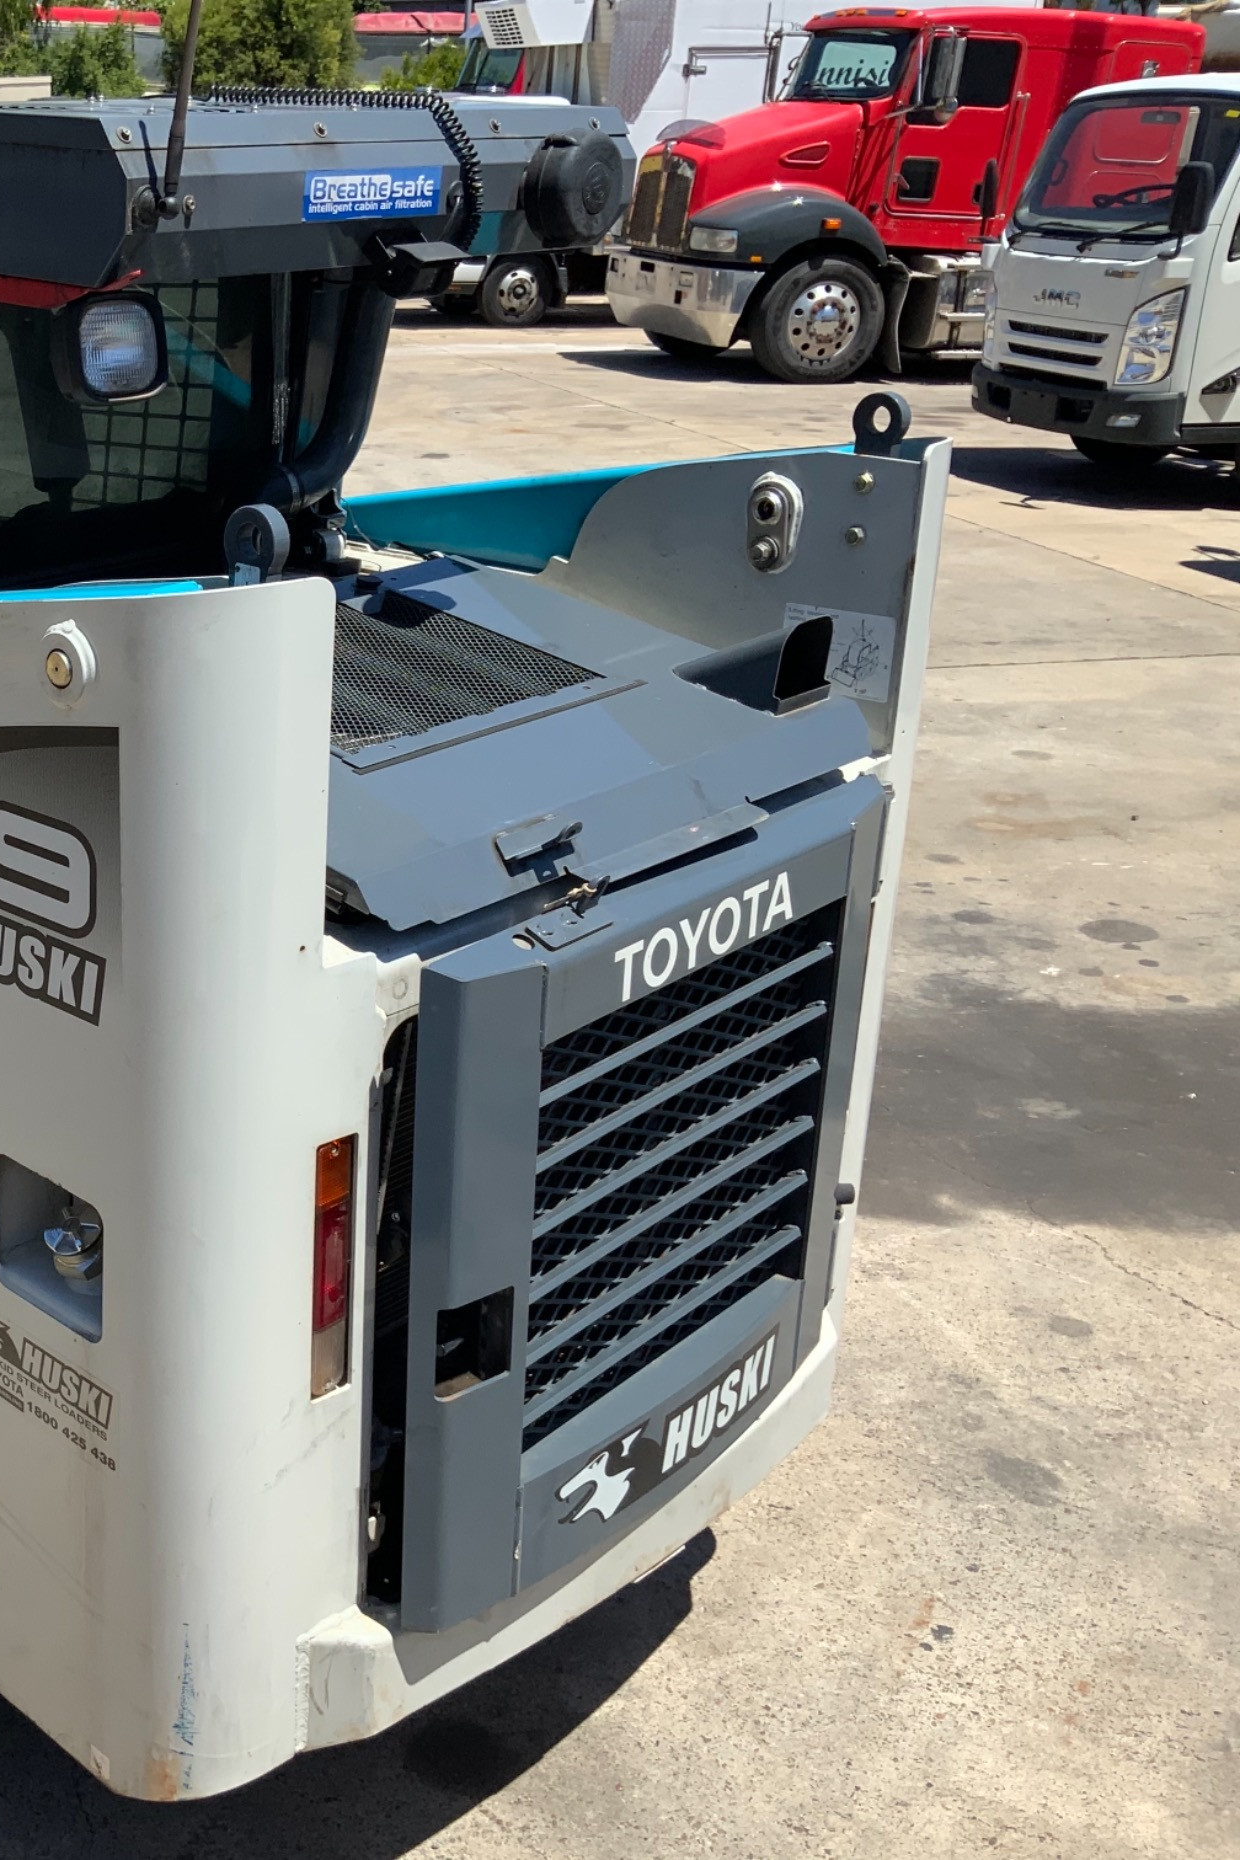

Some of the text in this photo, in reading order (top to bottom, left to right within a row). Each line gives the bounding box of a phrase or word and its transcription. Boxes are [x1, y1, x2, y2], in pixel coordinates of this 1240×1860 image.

[308, 199, 432, 214] intelligent cabin air filtration
[615, 871, 793, 1002] TOYOTA
[16, 1374, 52, 1403] STEER
[54, 1398, 108, 1441] LOADERS
[22, 1338, 112, 1428] HUSKI
[662, 1334, 776, 1474] HUSKI
[26, 1401, 116, 1471] 1800 425 438
